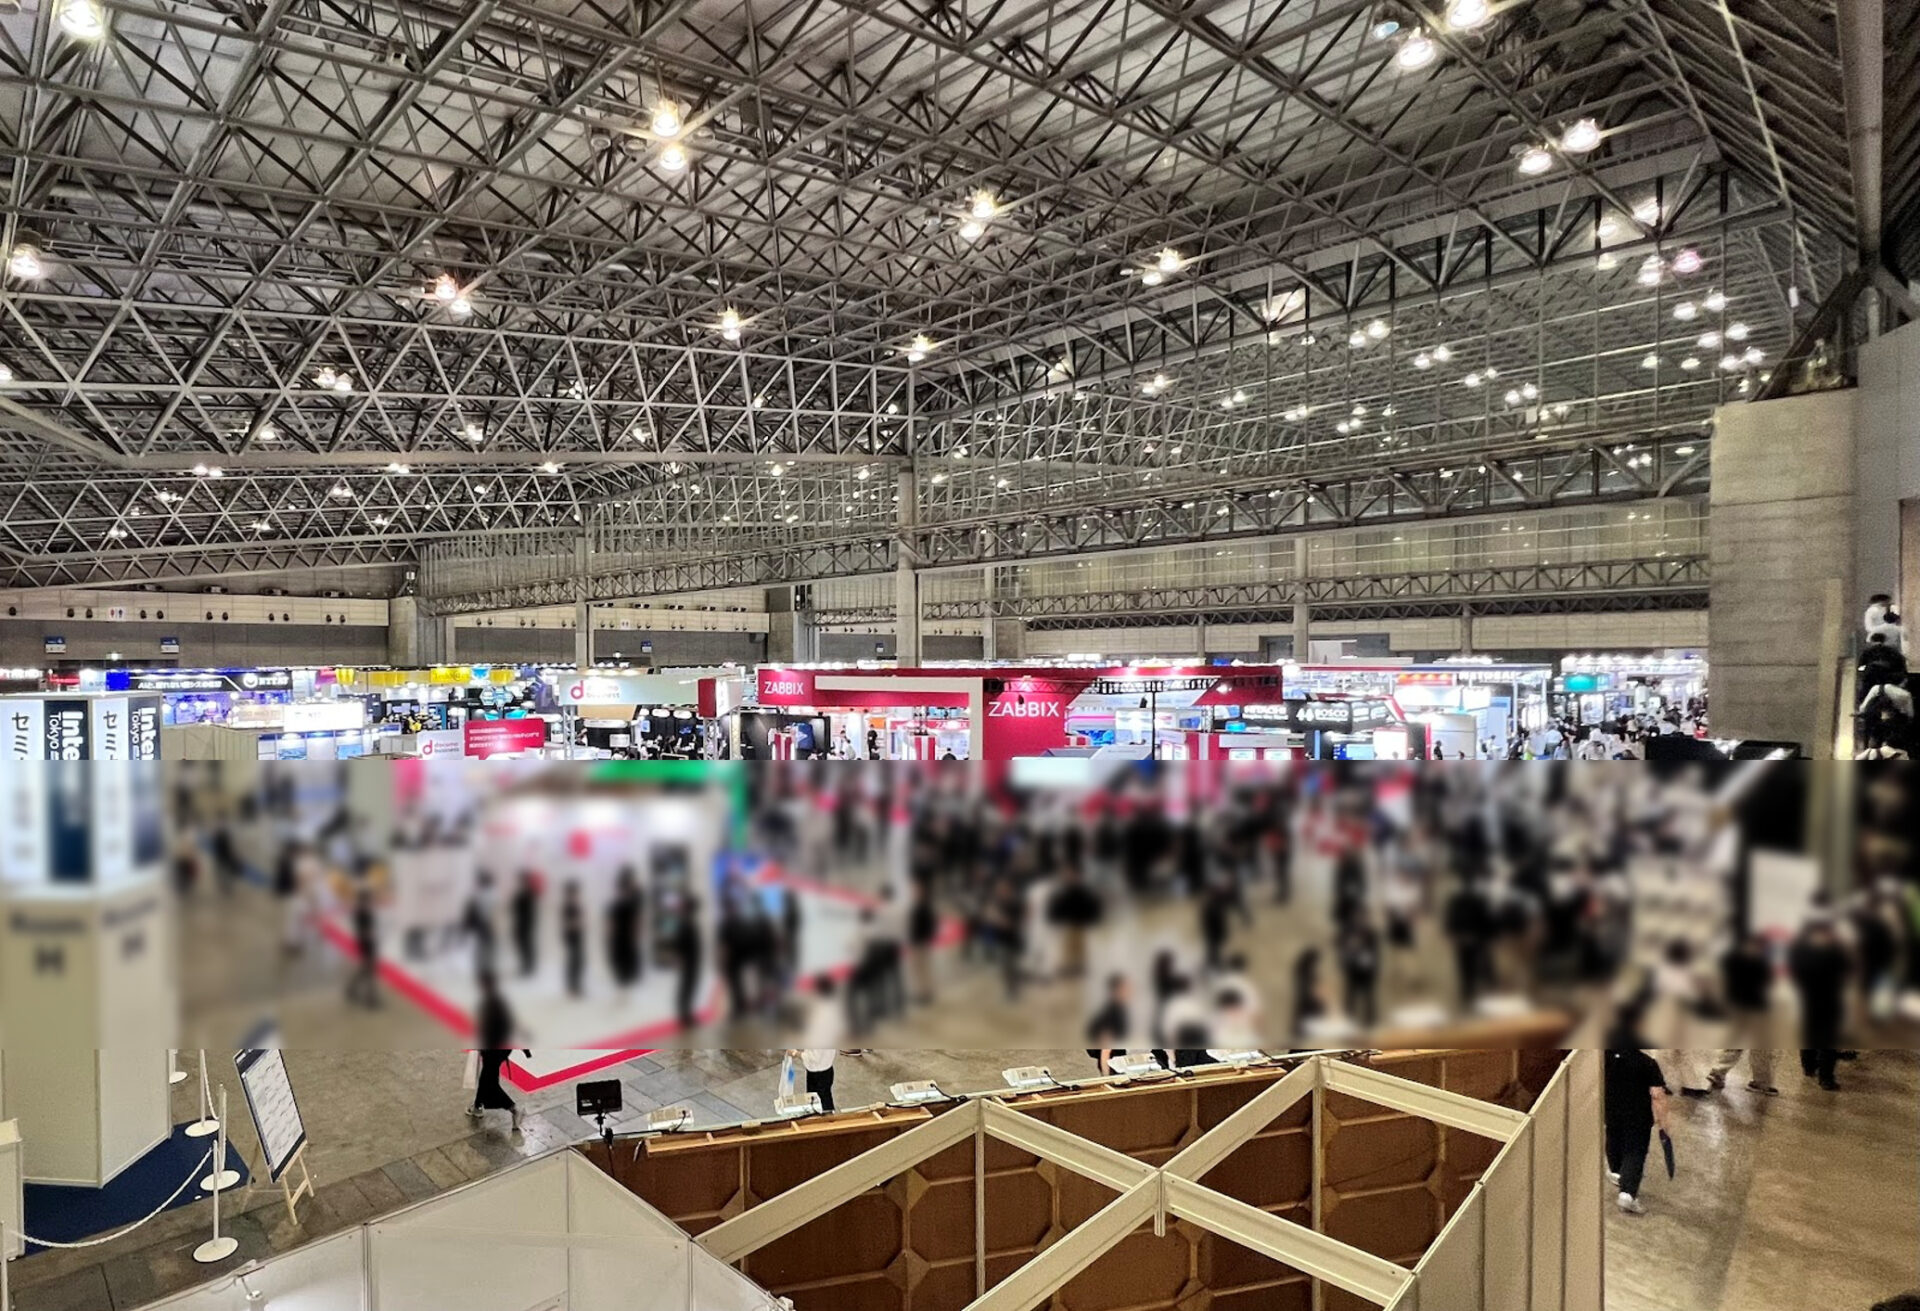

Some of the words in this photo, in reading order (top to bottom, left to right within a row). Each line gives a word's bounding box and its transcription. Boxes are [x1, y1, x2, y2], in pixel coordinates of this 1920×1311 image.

[764, 681, 804, 695] ZABBIX
[130, 708, 141, 745] Tokyo
[988, 702, 1059, 717] ZABBIX
[12, 712, 30, 760] セミ
[46, 712, 62, 750] Tokyo
